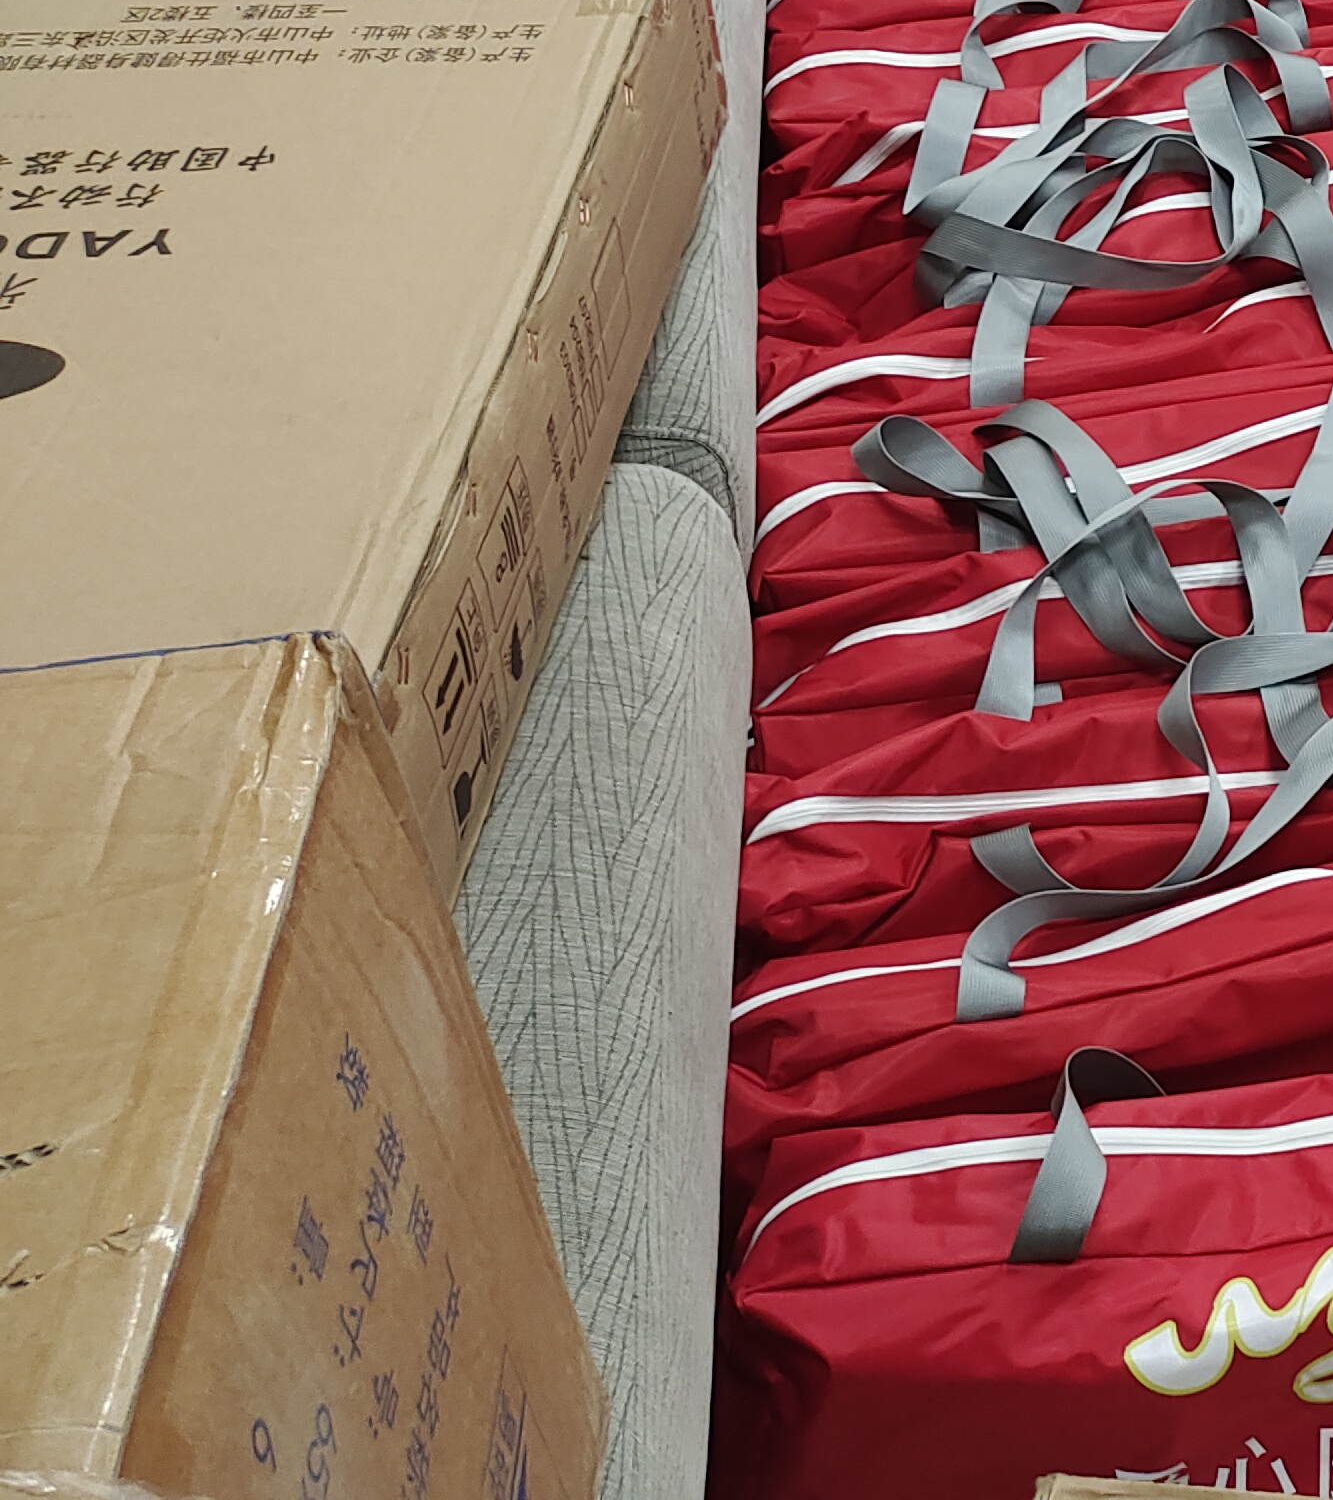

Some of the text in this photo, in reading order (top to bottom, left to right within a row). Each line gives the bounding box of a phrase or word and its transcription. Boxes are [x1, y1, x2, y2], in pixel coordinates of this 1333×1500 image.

[0, 146, 275, 176] 中国助行器
[0, 183, 163, 211] 行动不
[0, 228, 173, 260] YAD
